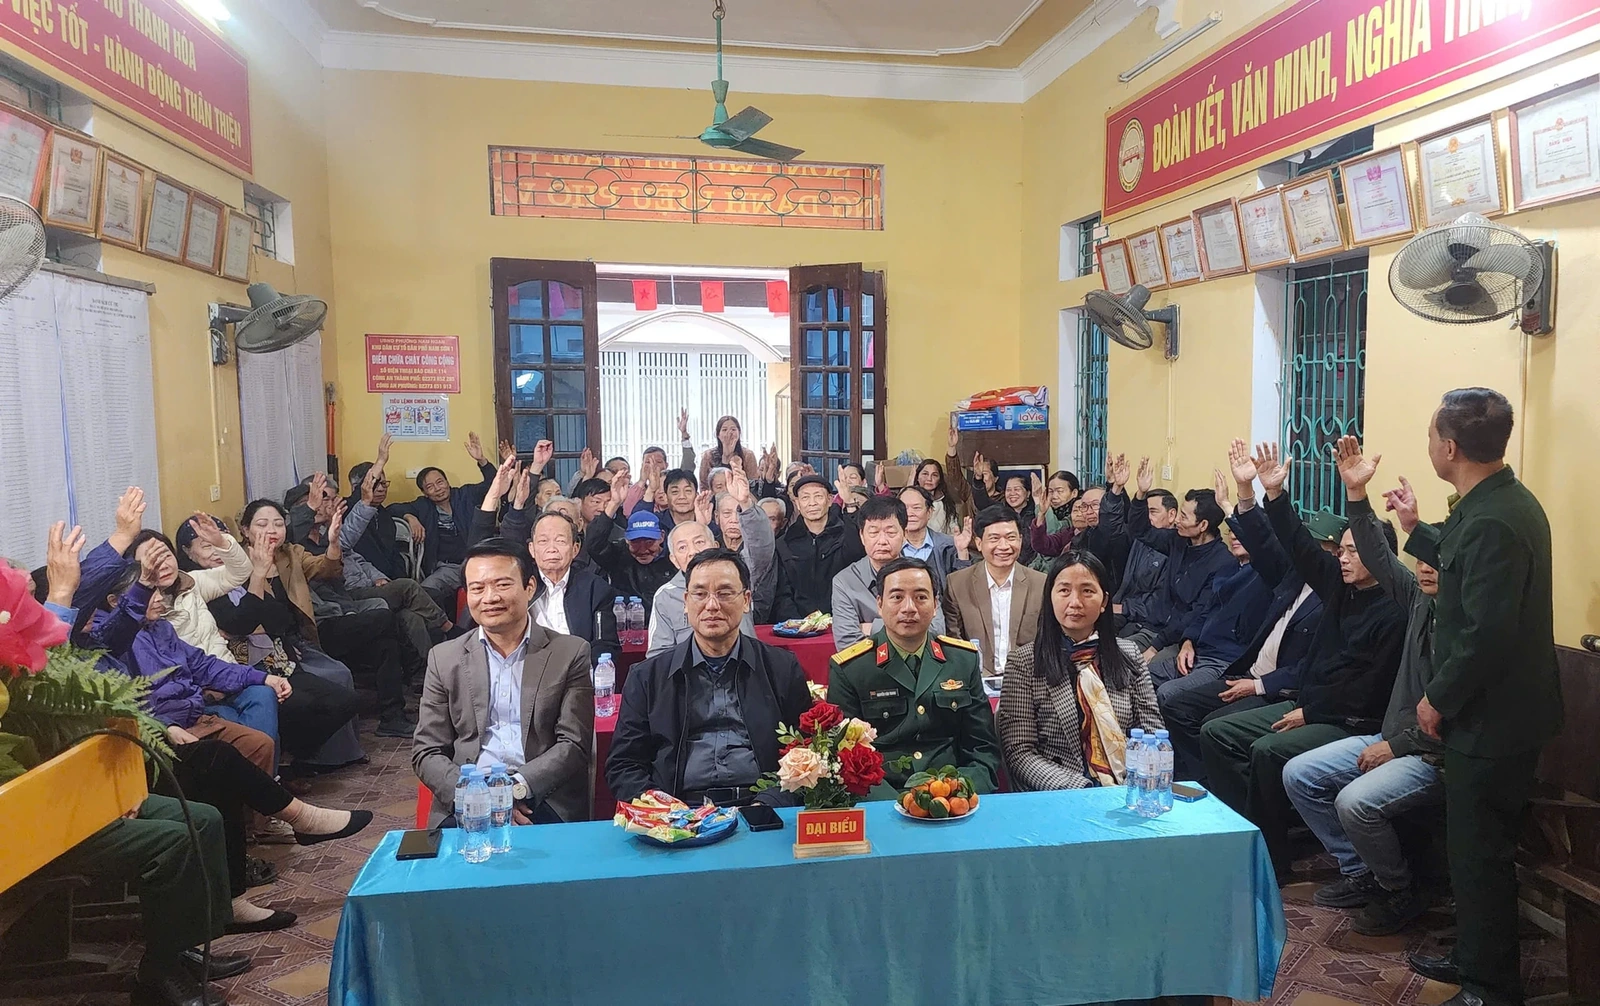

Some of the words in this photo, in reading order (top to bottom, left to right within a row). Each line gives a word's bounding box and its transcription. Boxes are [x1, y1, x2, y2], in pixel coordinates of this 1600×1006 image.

[128, 0, 170, 53] THANH
[173, 28, 197, 72] HÓA
[57, 2, 89, 56] TỐT
[104, 34, 145, 90] HÀNH
[147, 63, 182, 112] ĐỘNG
[183, 86, 213, 131] THÂN
[213, 106, 242, 150] THIỆN
[1152, 103, 1191, 173] ĐOÀN
[1195, 74, 1227, 150] KẾT,
[1231, 61, 1268, 138] VĂN
[1273, 30, 1338, 119] MINH,
[372, 351, 387, 364] ĐIỂM
[388, 354, 404, 364] CHỮA
[404, 353, 420, 365] CHÁY
[420, 353, 438, 365] CÔNG
[438, 353, 455, 367] CỘNG
[806, 822, 826, 837] ĐẠI
[829, 816, 857, 834] BIỂU
